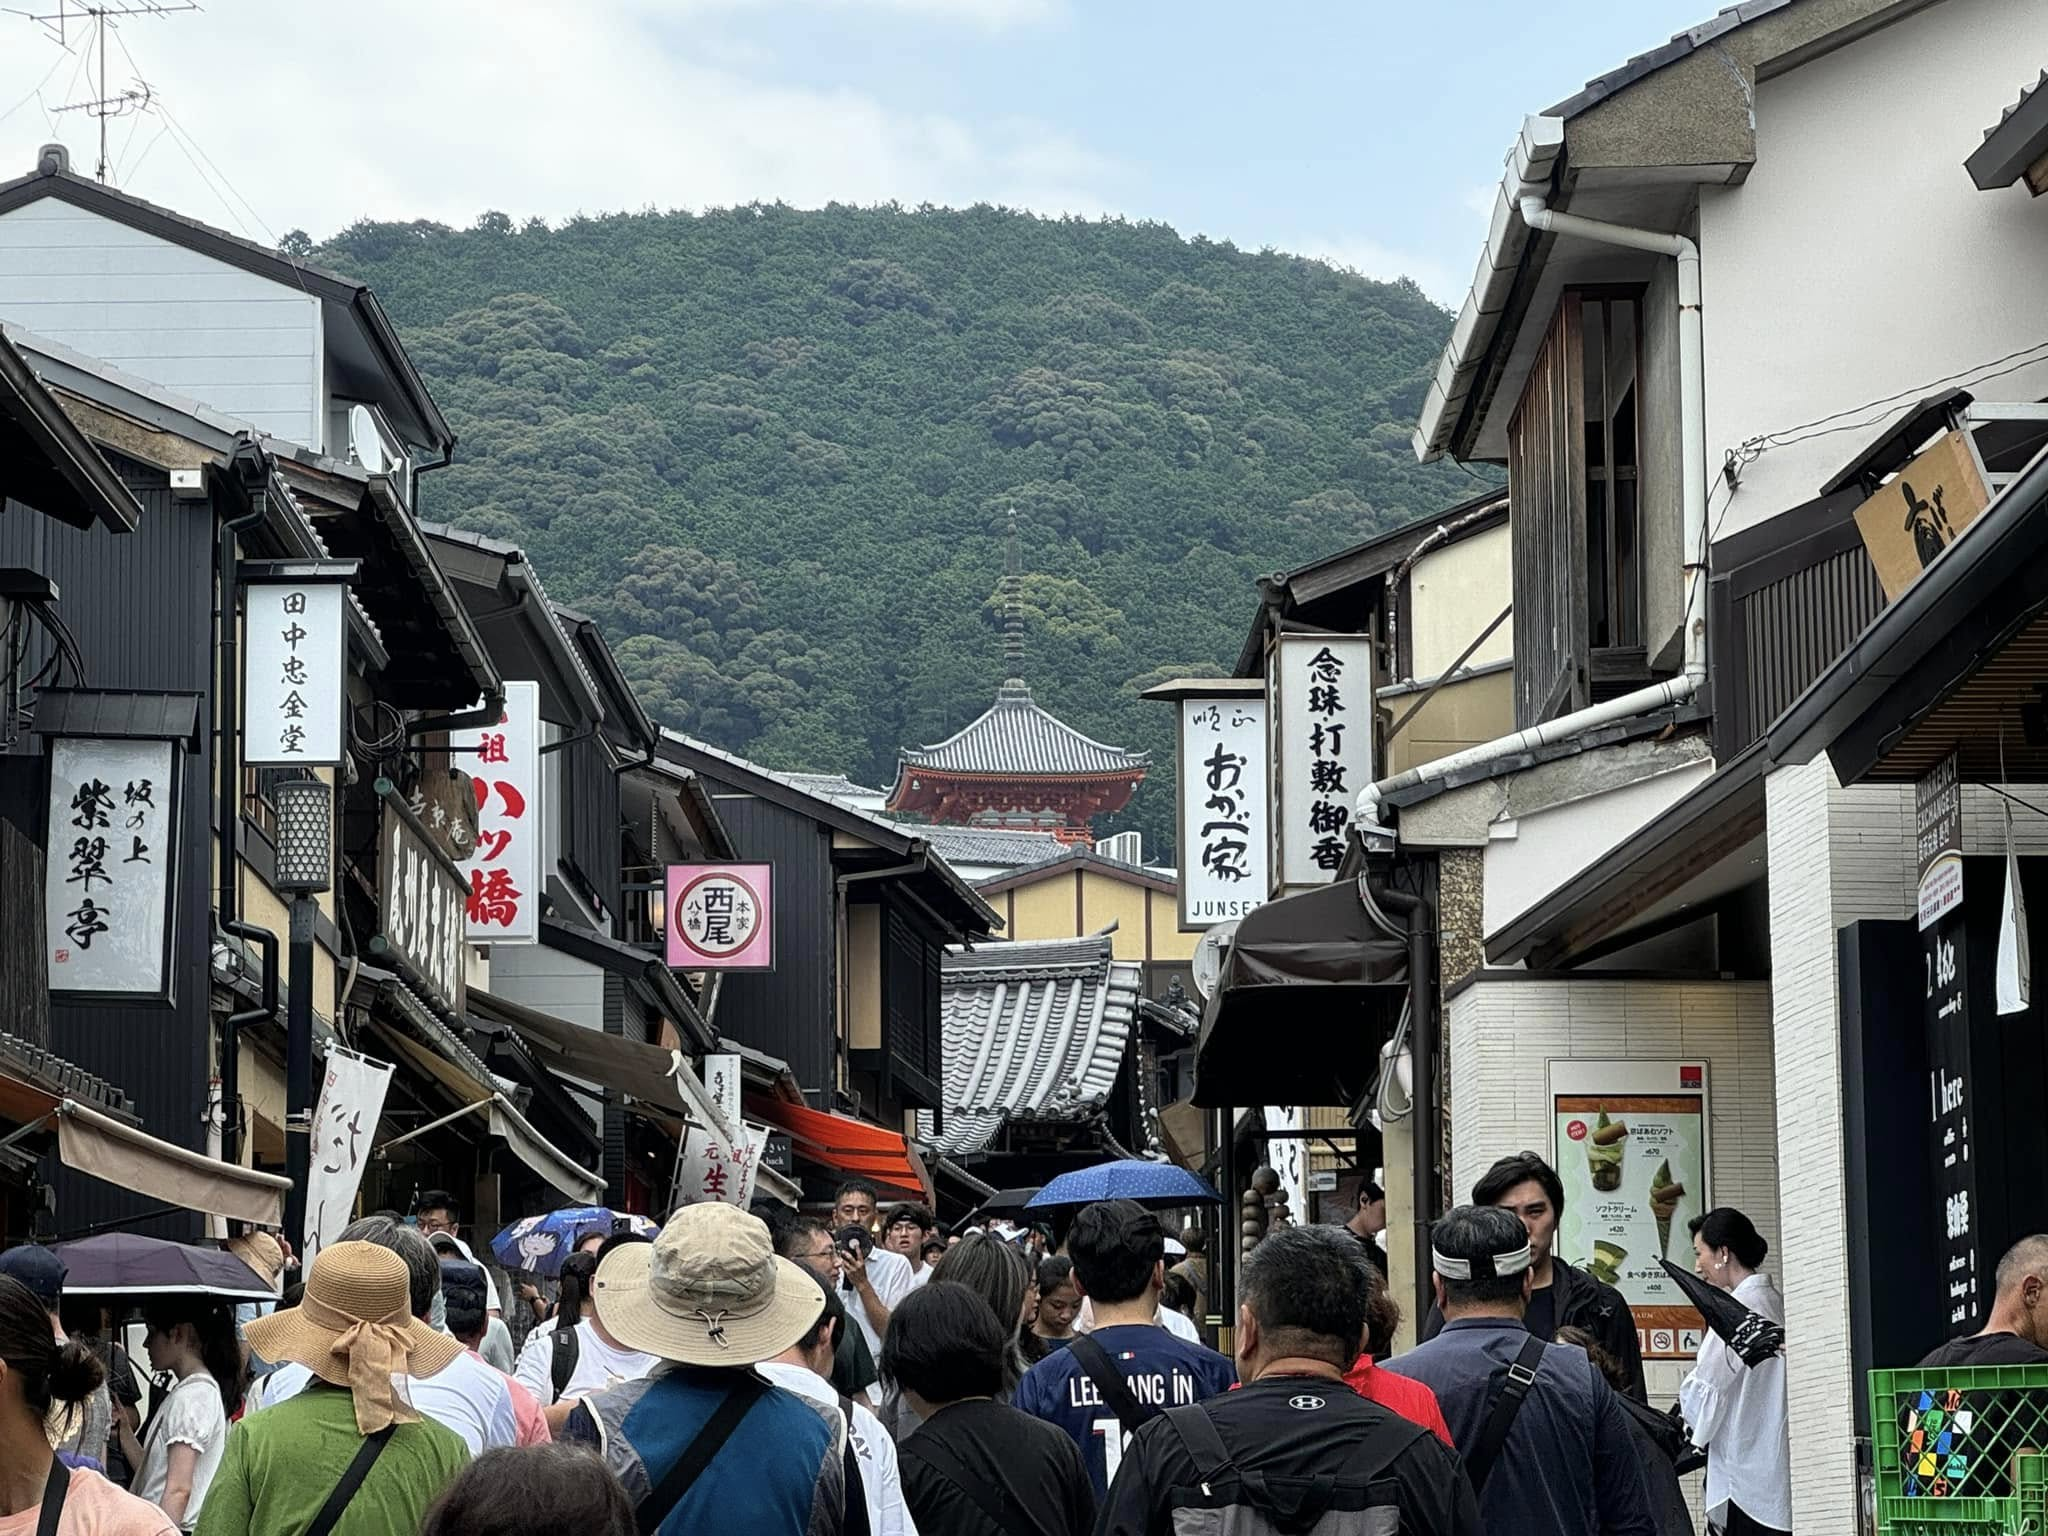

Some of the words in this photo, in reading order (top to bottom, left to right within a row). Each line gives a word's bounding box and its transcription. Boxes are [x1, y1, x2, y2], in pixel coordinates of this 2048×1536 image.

[279, 592, 308, 753] 田中忠金堂
[1917, 751, 1958, 808] CURRENCY
[123, 779, 155, 864] 坂の上
[1201, 742, 1251, 883] おかべ家
[1918, 789, 1950, 834] EXCHANGE
[65, 778, 115, 949] 紫翠亭
[700, 887, 735, 945] 西尾
[736, 901, 751, 930] 本家
[1941, 1068, 1963, 1115] here
[1070, 1376, 1103, 1407] LEE
